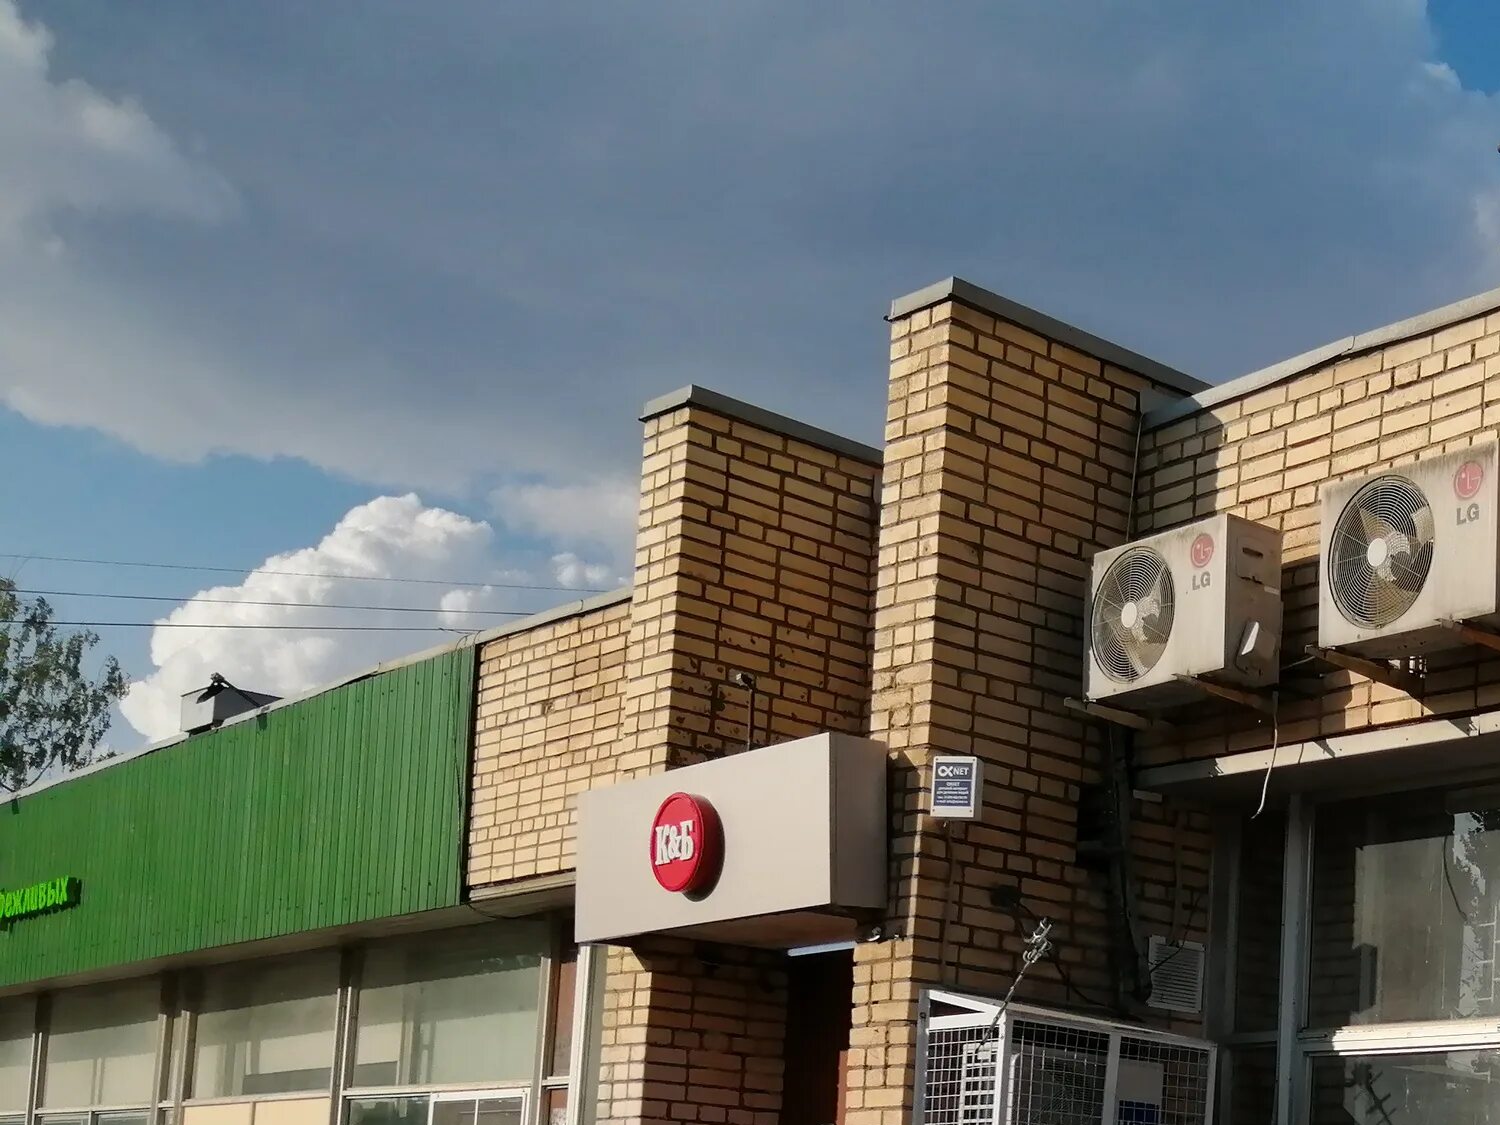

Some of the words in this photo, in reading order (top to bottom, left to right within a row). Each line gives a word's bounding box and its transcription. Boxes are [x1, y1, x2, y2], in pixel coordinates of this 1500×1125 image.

[1456, 503, 1480, 526] LG
[1192, 571, 1211, 591] LG
[655, 820, 695, 866] К&Б
